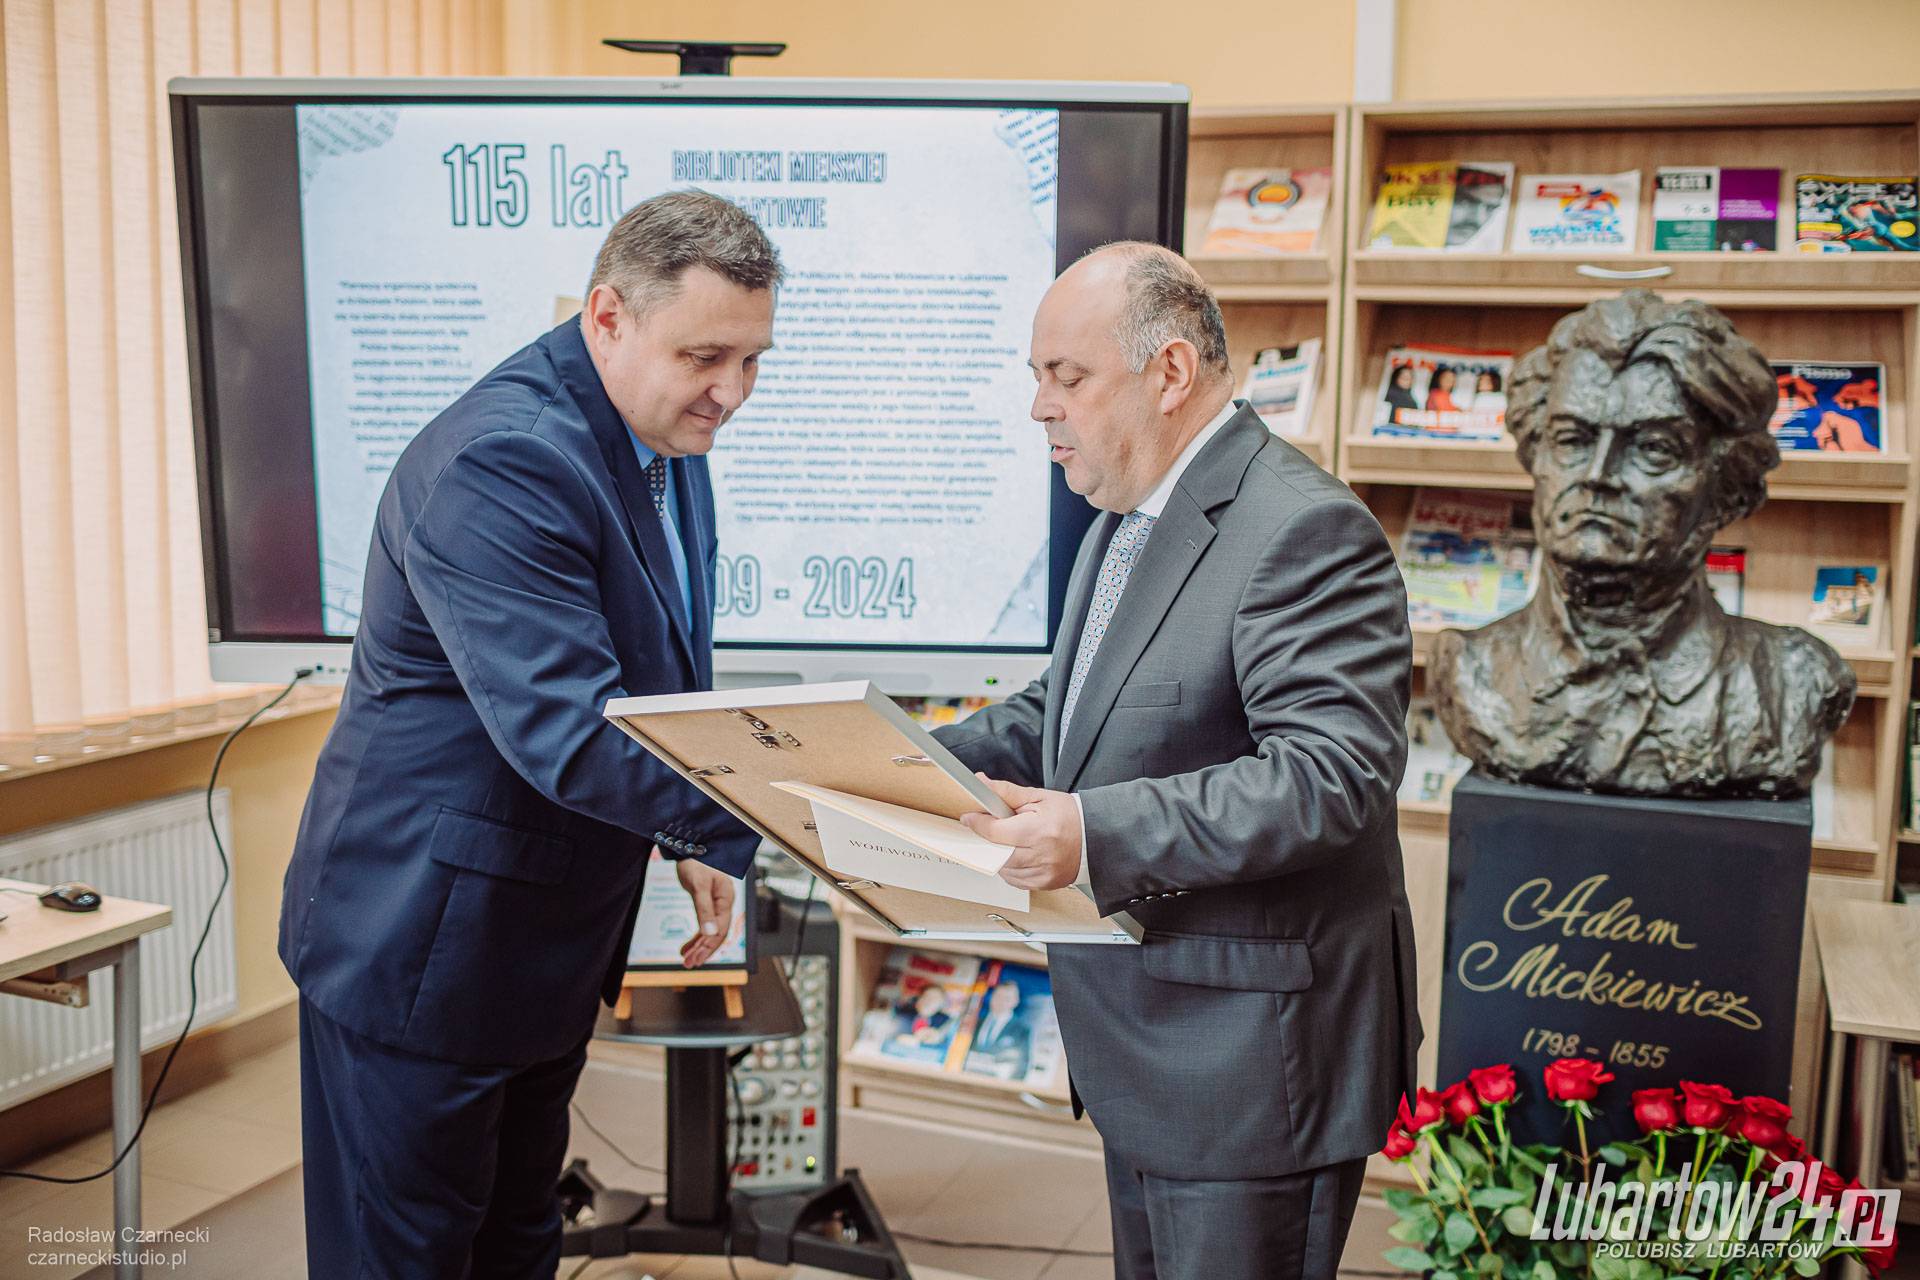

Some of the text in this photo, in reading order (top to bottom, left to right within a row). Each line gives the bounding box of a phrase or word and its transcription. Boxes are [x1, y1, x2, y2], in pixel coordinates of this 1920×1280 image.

[443, 144, 629, 228] 115 lat
[673, 151, 886, 183] BIBLIOTEKI MIEJSKIEJ
[727, 196, 827, 228] ARTOWIE
[715, 554, 761, 617] 09
[803, 556, 917, 619] 2024
[849, 839, 931, 861] WOJEWODA
[1503, 874, 1697, 949] Adam
[1457, 940, 1762, 1030] Mickiewicz
[1521, 1028, 1580, 1057] 1798
[1609, 1040, 1670, 1069] 1855
